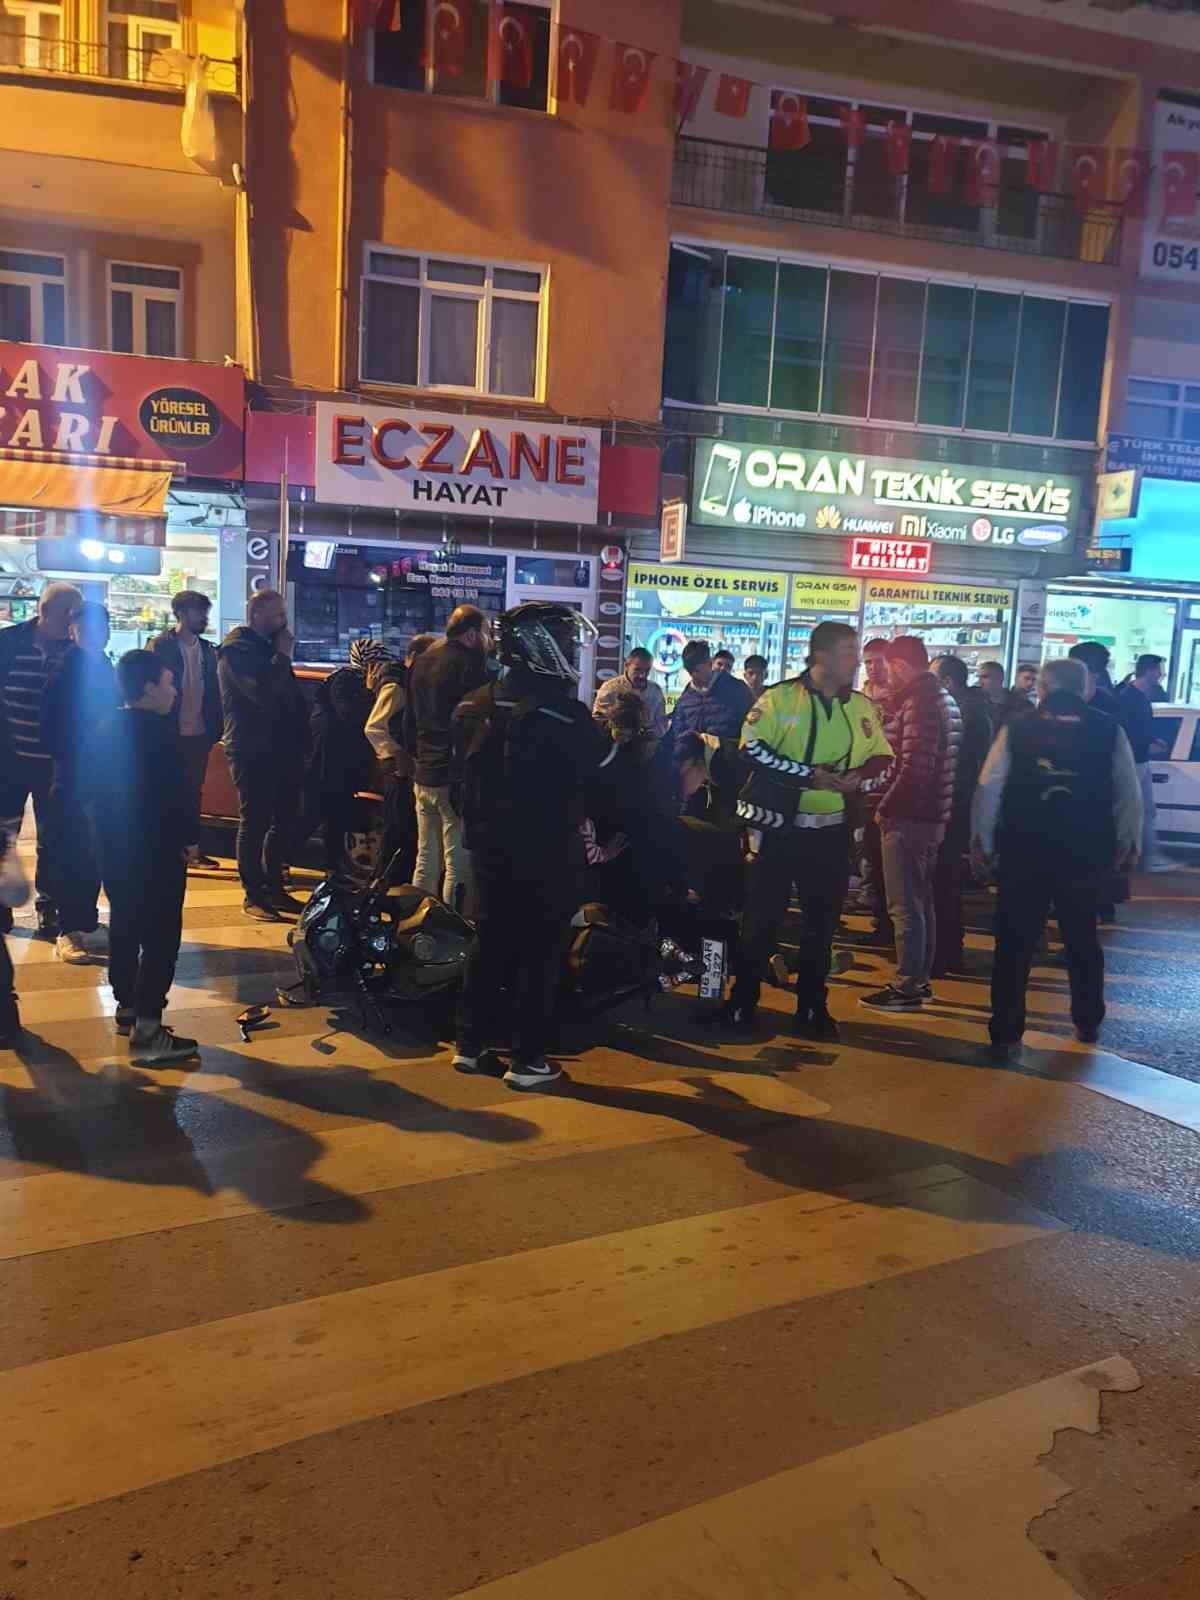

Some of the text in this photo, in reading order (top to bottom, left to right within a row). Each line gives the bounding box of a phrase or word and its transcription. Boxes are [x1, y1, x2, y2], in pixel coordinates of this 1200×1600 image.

[0, 359, 91, 403] AK
[151, 397, 209, 416] YÖRESEL
[0, 405, 119, 453] ARI
[150, 416, 211, 436] ÜRÜNLER
[332, 415, 587, 486] ECZANE
[413, 479, 508, 507] HAYAT
[745, 449, 1071, 515] ORAN TEKNİK SERVİS
[843, 516, 895, 535] HUAWEI
[926, 524, 967, 542] Xiaomi
[992, 526, 1015, 545] LG
[693, 573, 729, 591] ÖZEL
[796, 580, 858, 592] ORAN GSM
